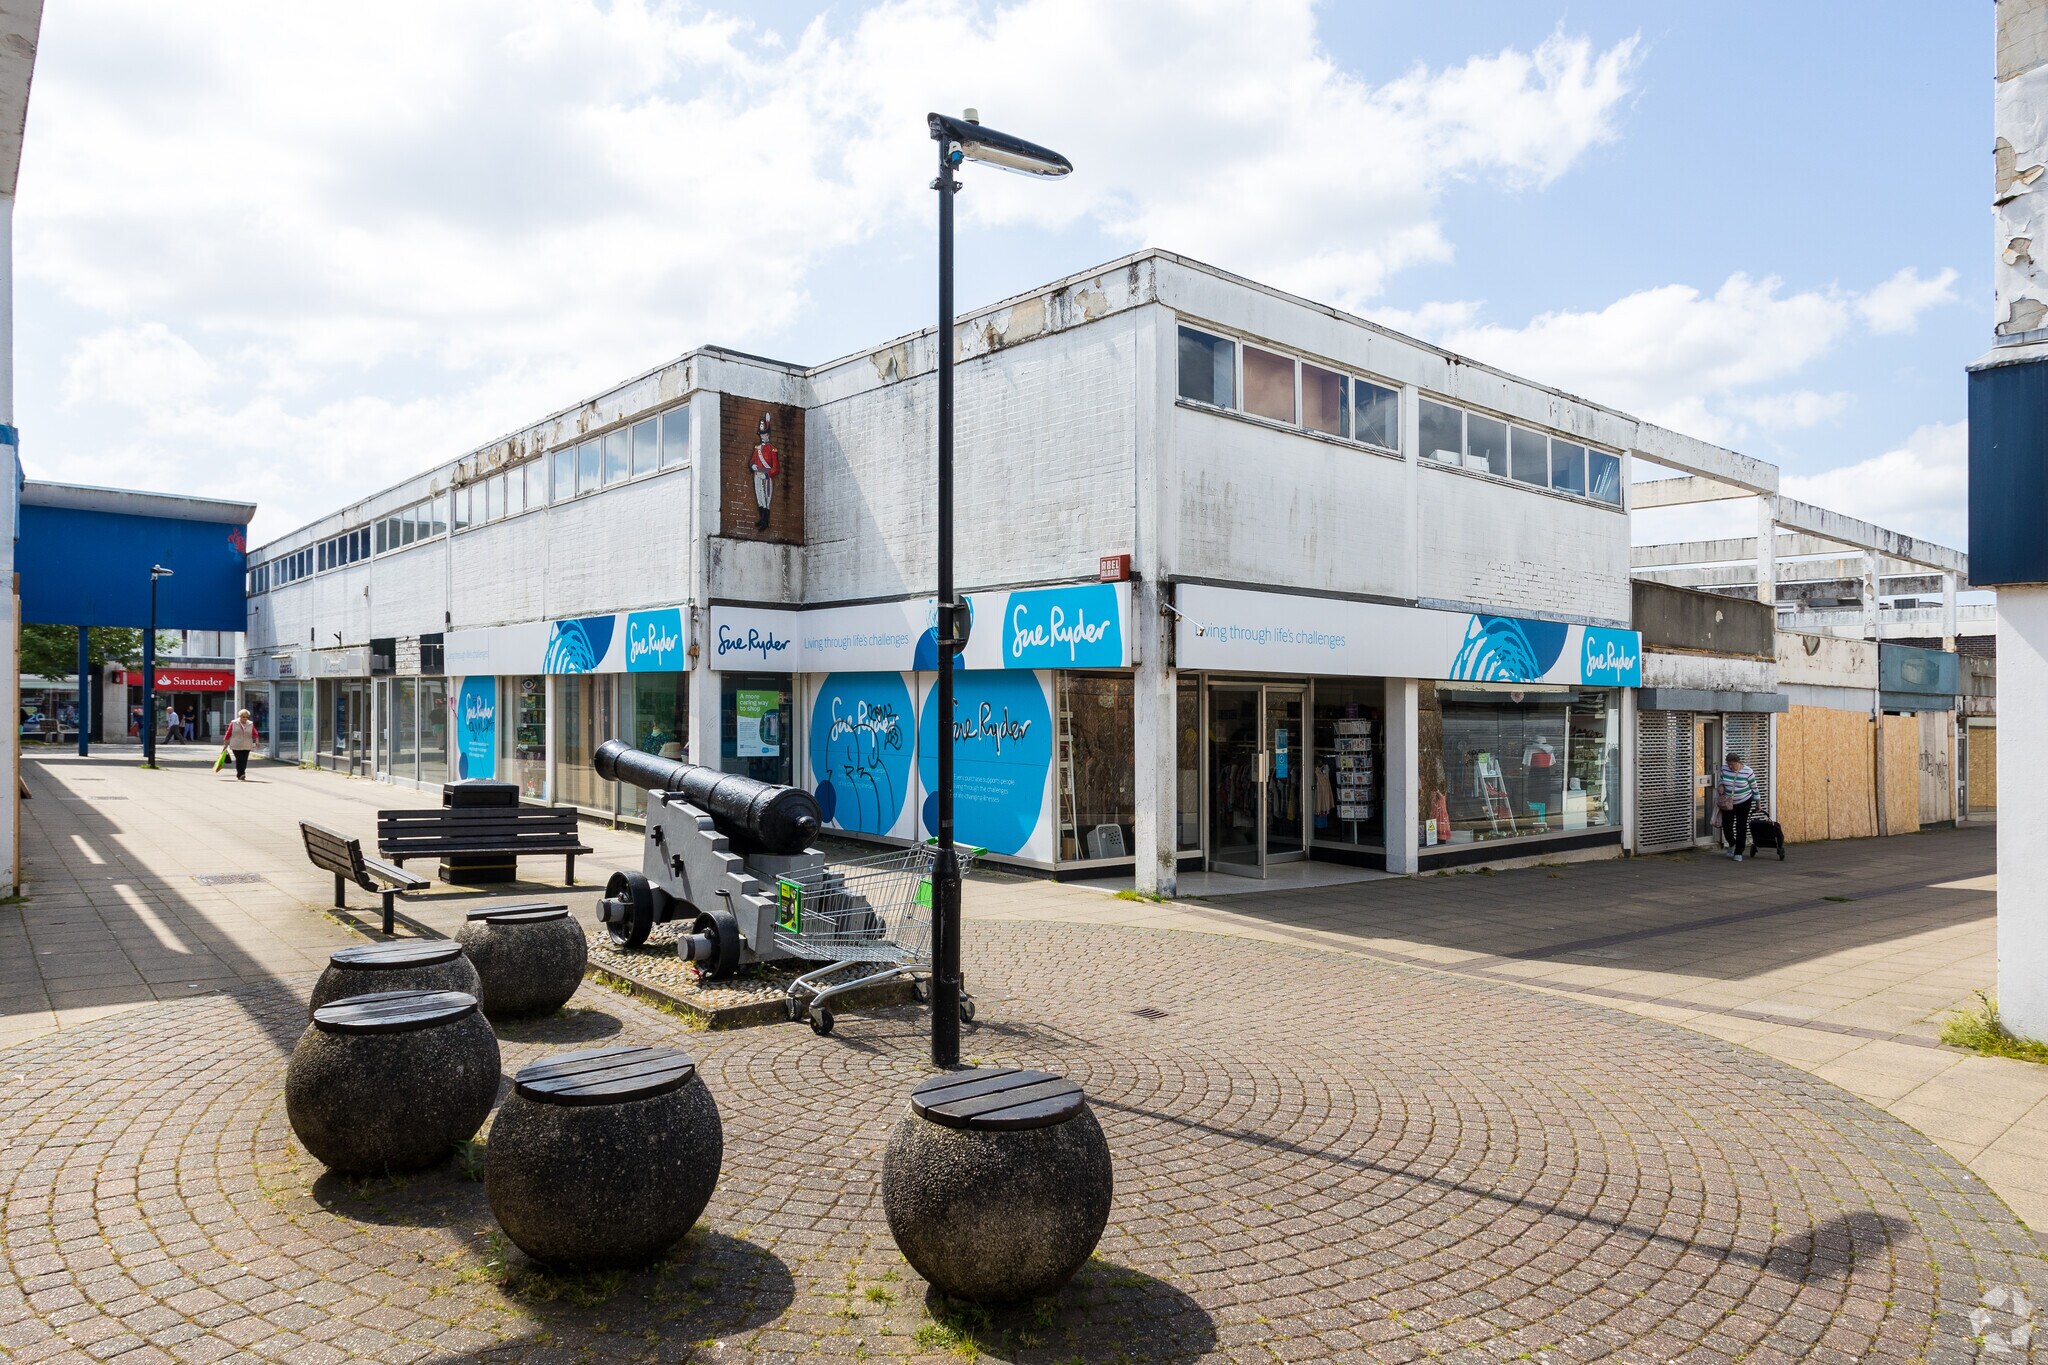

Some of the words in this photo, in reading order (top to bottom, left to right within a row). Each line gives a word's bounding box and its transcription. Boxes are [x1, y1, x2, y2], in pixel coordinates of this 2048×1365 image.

[1101, 560, 1119, 570] ABEL
[630, 622, 649, 664] Sue
[648, 623, 678, 666] Ryder
[718, 624, 747, 655] Sue
[748, 628, 791, 660] Ryder
[804, 636, 823, 651] Living
[824, 635, 852, 650] through
[852, 633, 868, 647] life's
[869, 633, 909, 648] challenges
[1012, 604, 1049, 657] Sue
[1050, 605, 1111, 662] Ryder
[1229, 625, 1272, 645] through
[1274, 627, 1294, 644] life's
[1296, 629, 1346, 649] challenges
[1586, 636, 1607, 677] Sue
[1607, 641, 1636, 682] Ryder
[173, 676, 223, 686] Santander
[465, 693, 477, 725] Sue
[831, 696, 854, 741] Sue
[858, 700, 899, 748] Ryder
[952, 697, 978, 741] ue
[978, 701, 1031, 756] Ryder
